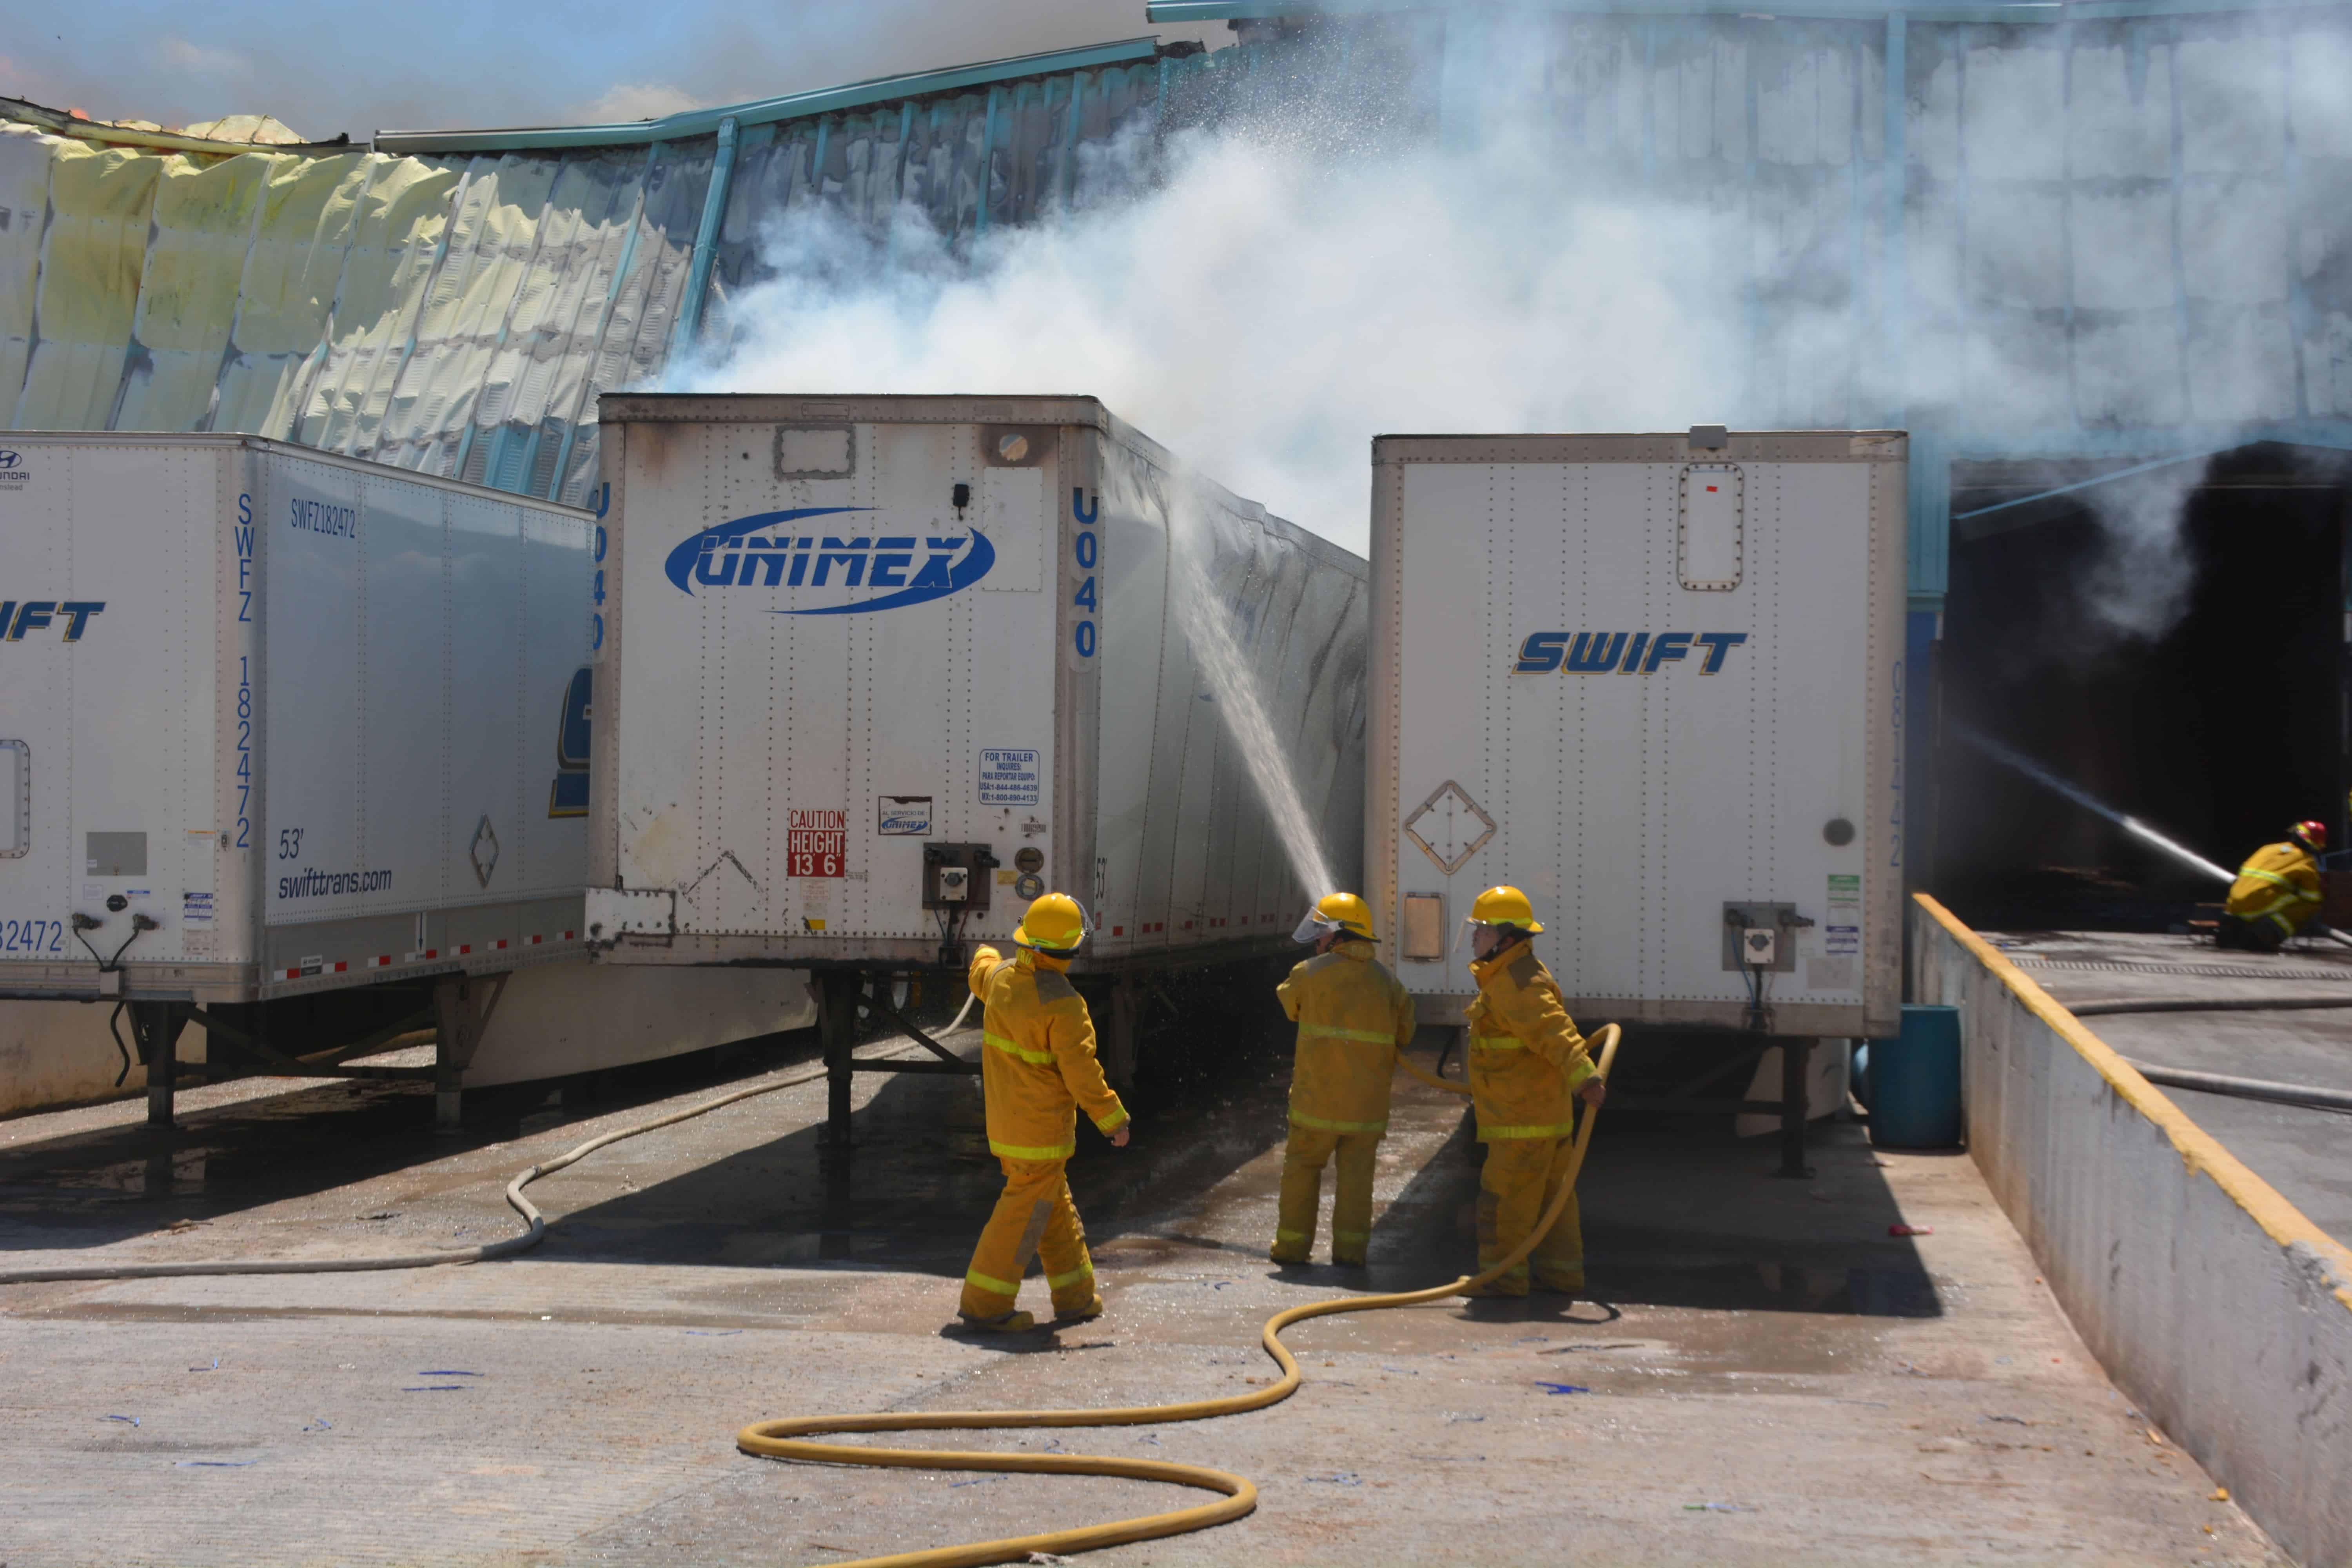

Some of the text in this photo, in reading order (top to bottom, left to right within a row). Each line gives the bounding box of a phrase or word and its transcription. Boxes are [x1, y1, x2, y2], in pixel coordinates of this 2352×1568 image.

[291, 498, 355, 539] SWFZ182472
[695, 536, 968, 588] UNIMEX
[1073, 487, 1098, 657] U040
[235, 493, 254, 848] SWFZ 182472
[1512, 632, 1748, 675] SWIFT
[985, 752, 1033, 762] FOR TRAILER
[791, 810, 845, 828] CAUTION
[279, 828, 304, 860] 53'
[791, 831, 843, 853] HEIGHT
[279, 867, 392, 898] swifttrans.com
